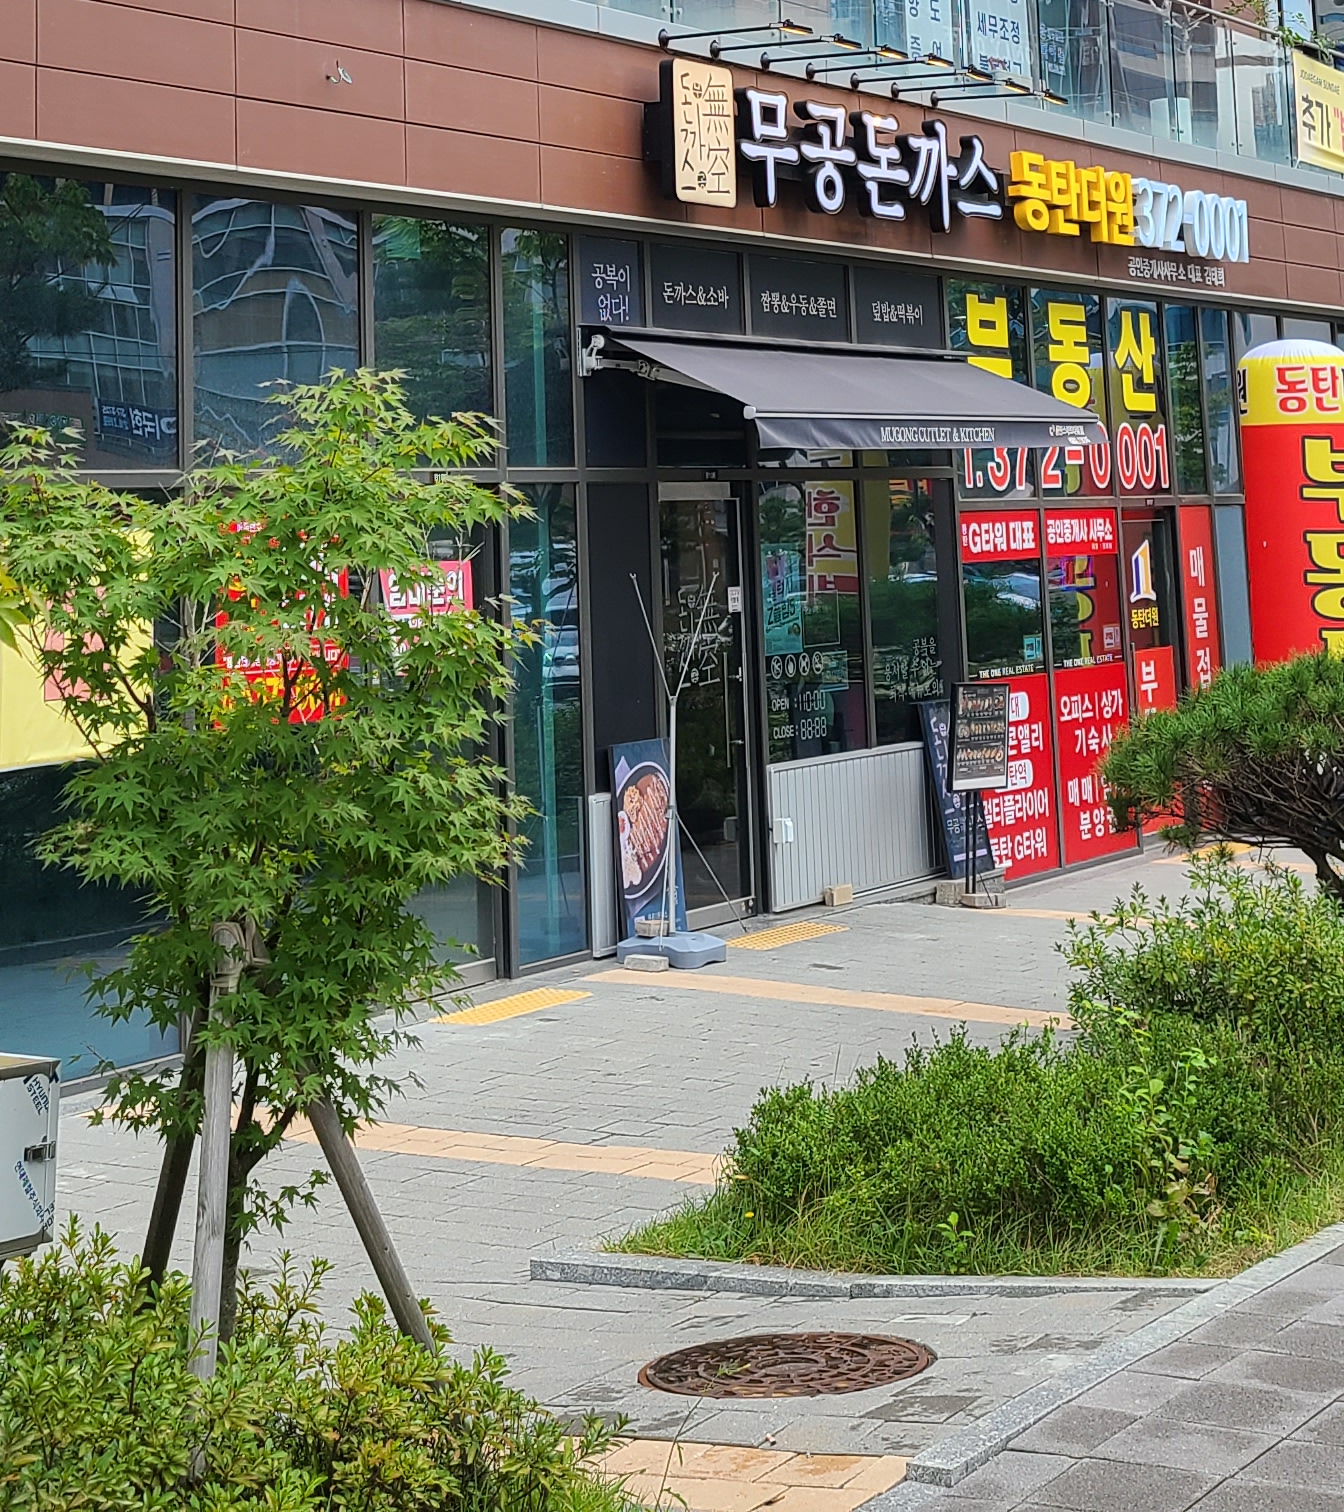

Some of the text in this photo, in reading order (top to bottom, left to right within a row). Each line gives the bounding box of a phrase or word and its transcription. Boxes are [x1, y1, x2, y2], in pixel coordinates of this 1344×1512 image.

[977, 10, 1021, 45] 세무조정
[1301, 94, 1331, 149] 추가
[741, 87, 1249, 264] 무공돈까스 동탄더원 372-0001
[591, 262, 631, 292] 공복이
[1187, 263, 1203, 284] 대표
[598, 293, 630, 323] 없다!
[662, 281, 730, 310] 돈까스&소바
[760, 291, 838, 320] 짬뽕&우동&쫄면
[871, 301, 924, 326] 덮밥&떡볶이
[880, 426, 918, 443] MUGONG
[918, 426, 952, 443] CUTLET
[960, 426, 996, 443] KITCHEN
[968, 521, 1007, 554] G타워
[1008, 520, 1036, 551] 대표
[1046, 517, 1113, 544] 공인중개사 사무소
[1130, 606, 1160, 630] 동탄더원
[1015, 664, 1034, 675] ESTATE
[1096, 653, 1114, 663] ESTATE
[771, 697, 790, 712] OPEN
[1059, 688, 1123, 723] 오피스 상가
[773, 724, 795, 740] CLOSE
[983, 787, 1049, 830] 멀티플라이어
[1014, 826, 1048, 861] G타워
[26, 1083, 46, 1116] STEEL
